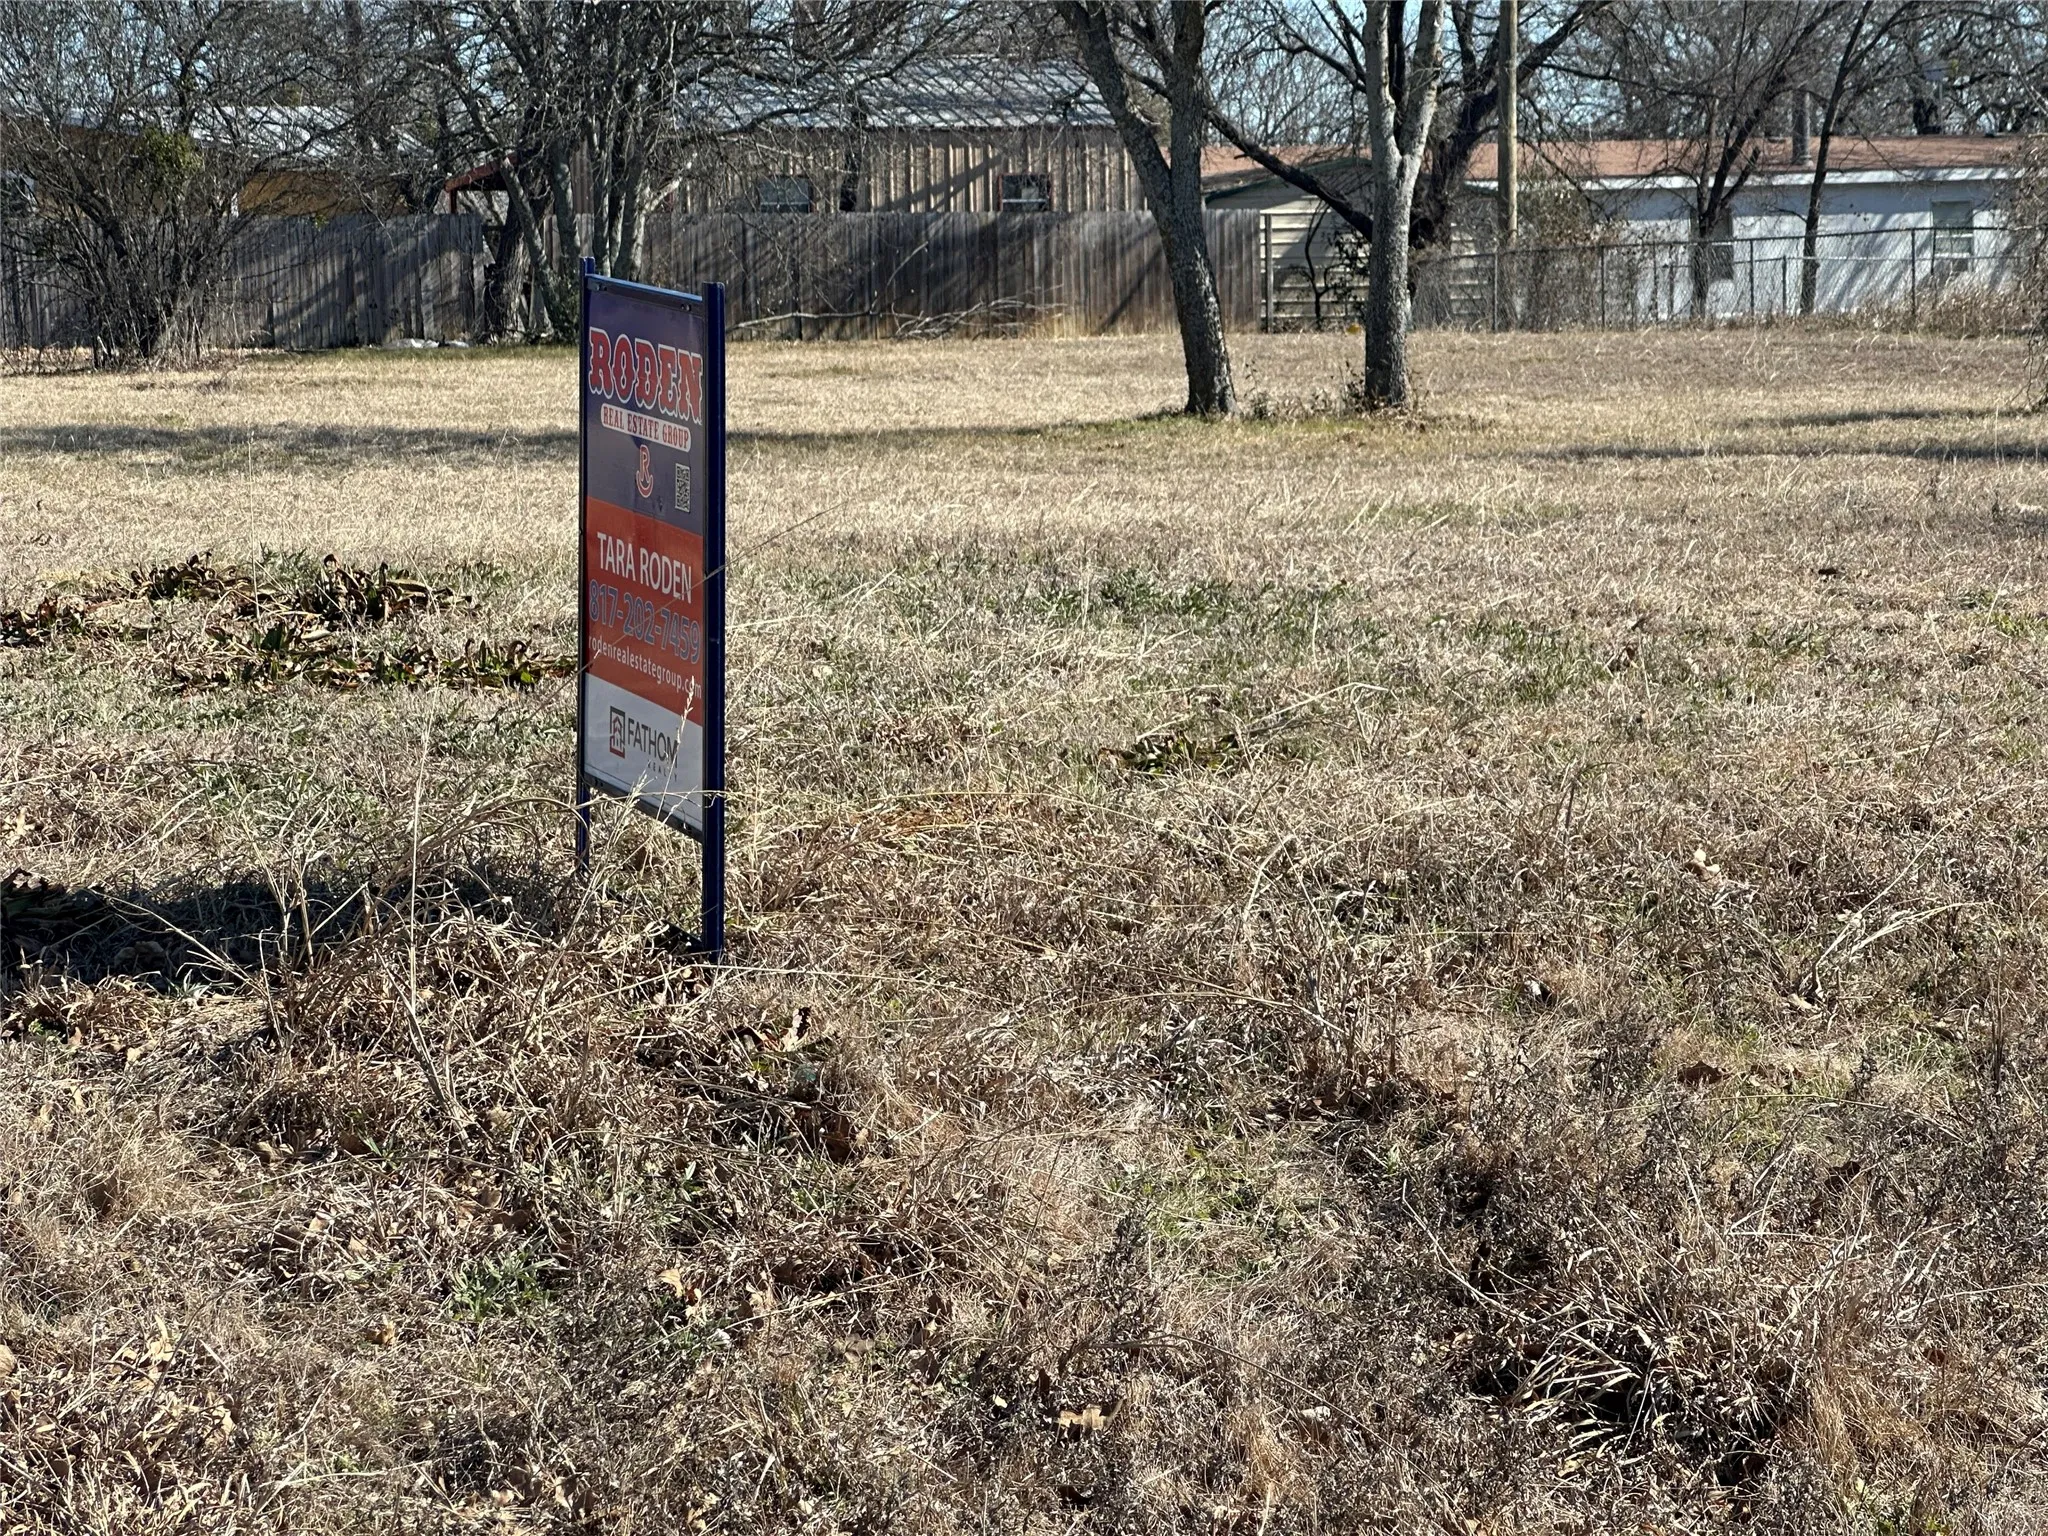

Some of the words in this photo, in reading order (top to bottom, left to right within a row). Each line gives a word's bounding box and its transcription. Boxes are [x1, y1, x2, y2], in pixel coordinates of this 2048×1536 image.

[588, 326, 703, 425] RODEN
[603, 406, 625, 430] REAL
[627, 413, 659, 440] ESTATE
[662, 423, 689, 449] GROUP
[597, 532, 636, 581] TARA
[639, 547, 692, 604] RODEN
[589, 579, 701, 664] 817-202-7459
[628, 717, 678, 768] FATHOM
